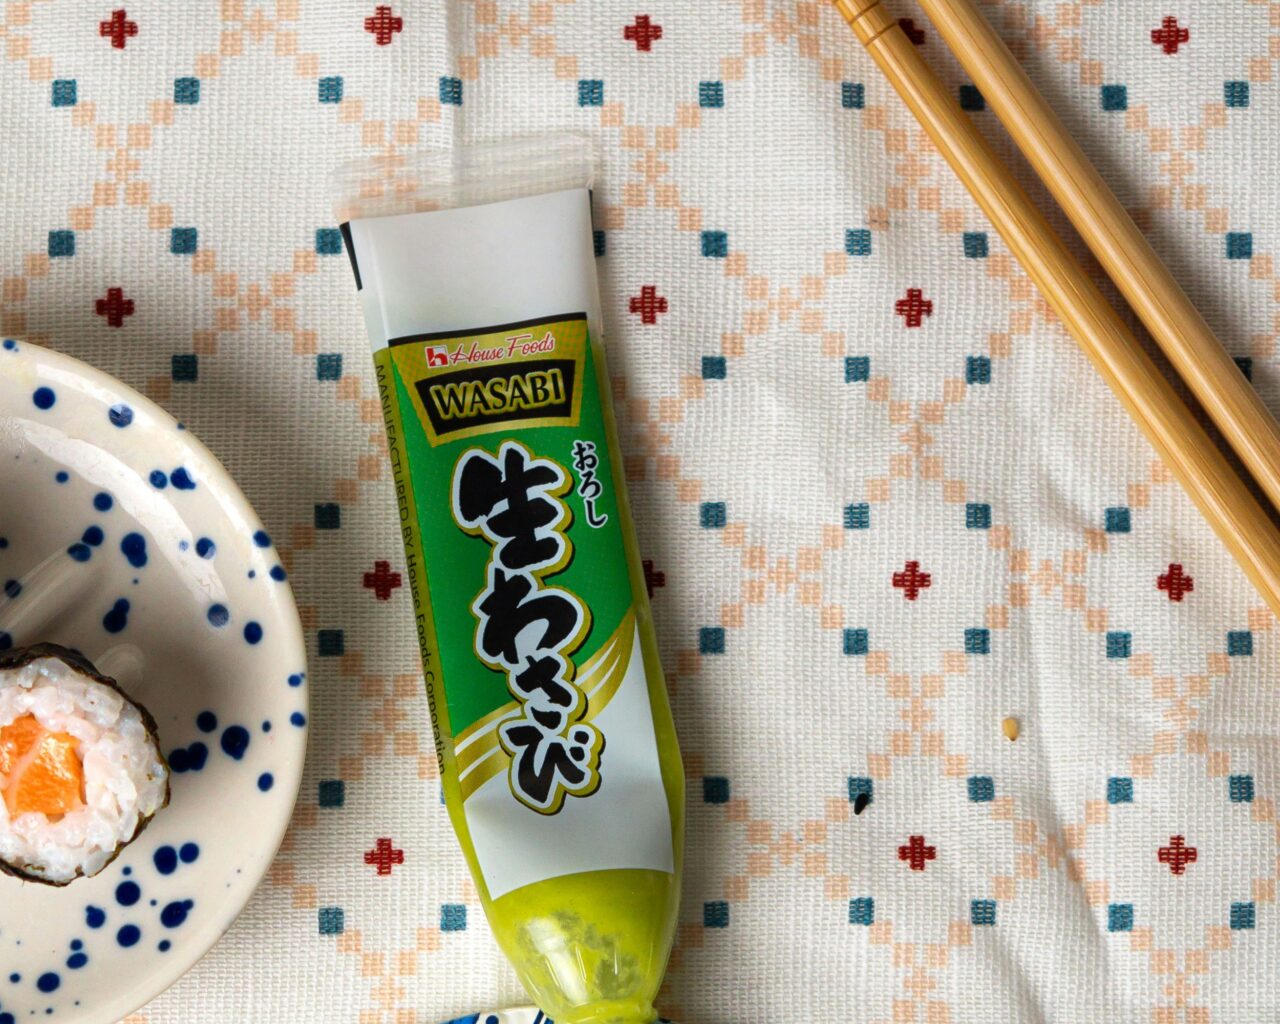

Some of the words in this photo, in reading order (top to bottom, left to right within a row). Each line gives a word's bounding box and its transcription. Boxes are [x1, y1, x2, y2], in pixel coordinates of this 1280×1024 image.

[450, 343, 504, 364] House
[506, 332, 555, 358] Foods
[430, 369, 565, 420] WASABI
[572, 441, 607, 527] おろし
[403, 526, 414, 548] BY
[416, 613, 431, 667] Foods
[455, 443, 595, 808] 生わさび
